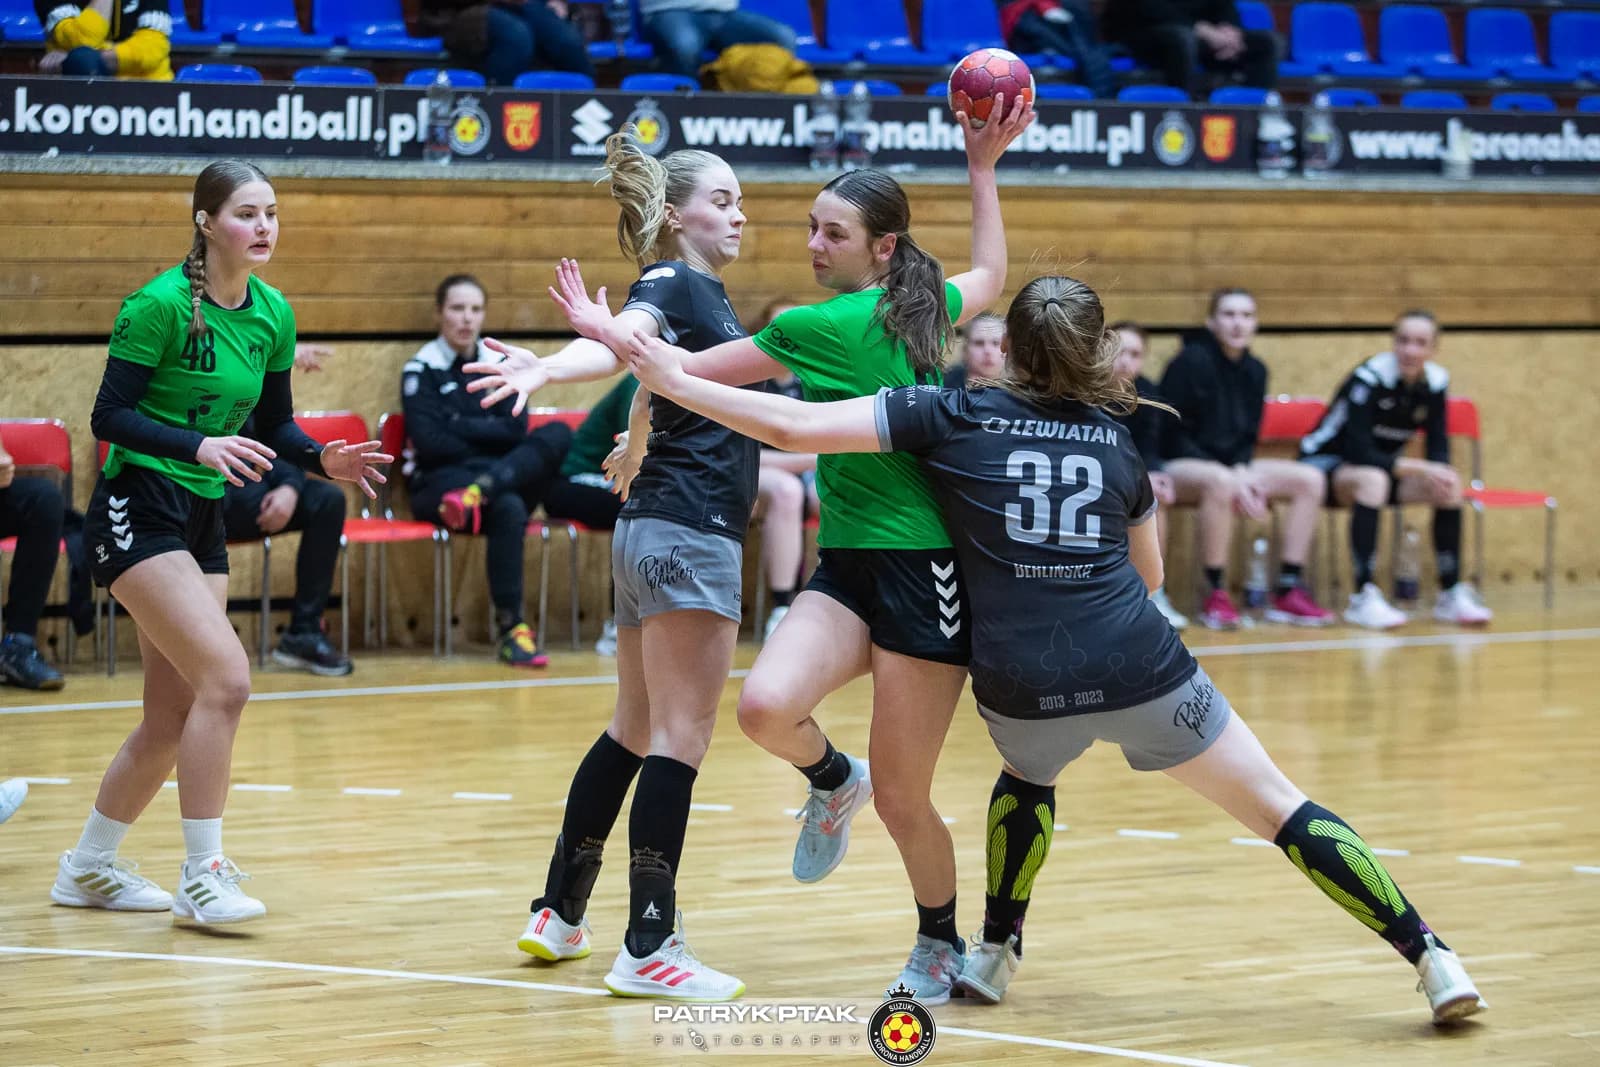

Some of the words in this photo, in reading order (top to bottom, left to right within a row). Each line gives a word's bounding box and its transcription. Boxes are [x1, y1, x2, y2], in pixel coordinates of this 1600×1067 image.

[180, 328, 217, 373] 48
[1010, 419, 1118, 448] LEWIATAN
[1004, 449, 1104, 548] 32
[1039, 694, 1066, 711] 2013
[1073, 689, 1105, 706] 2023
